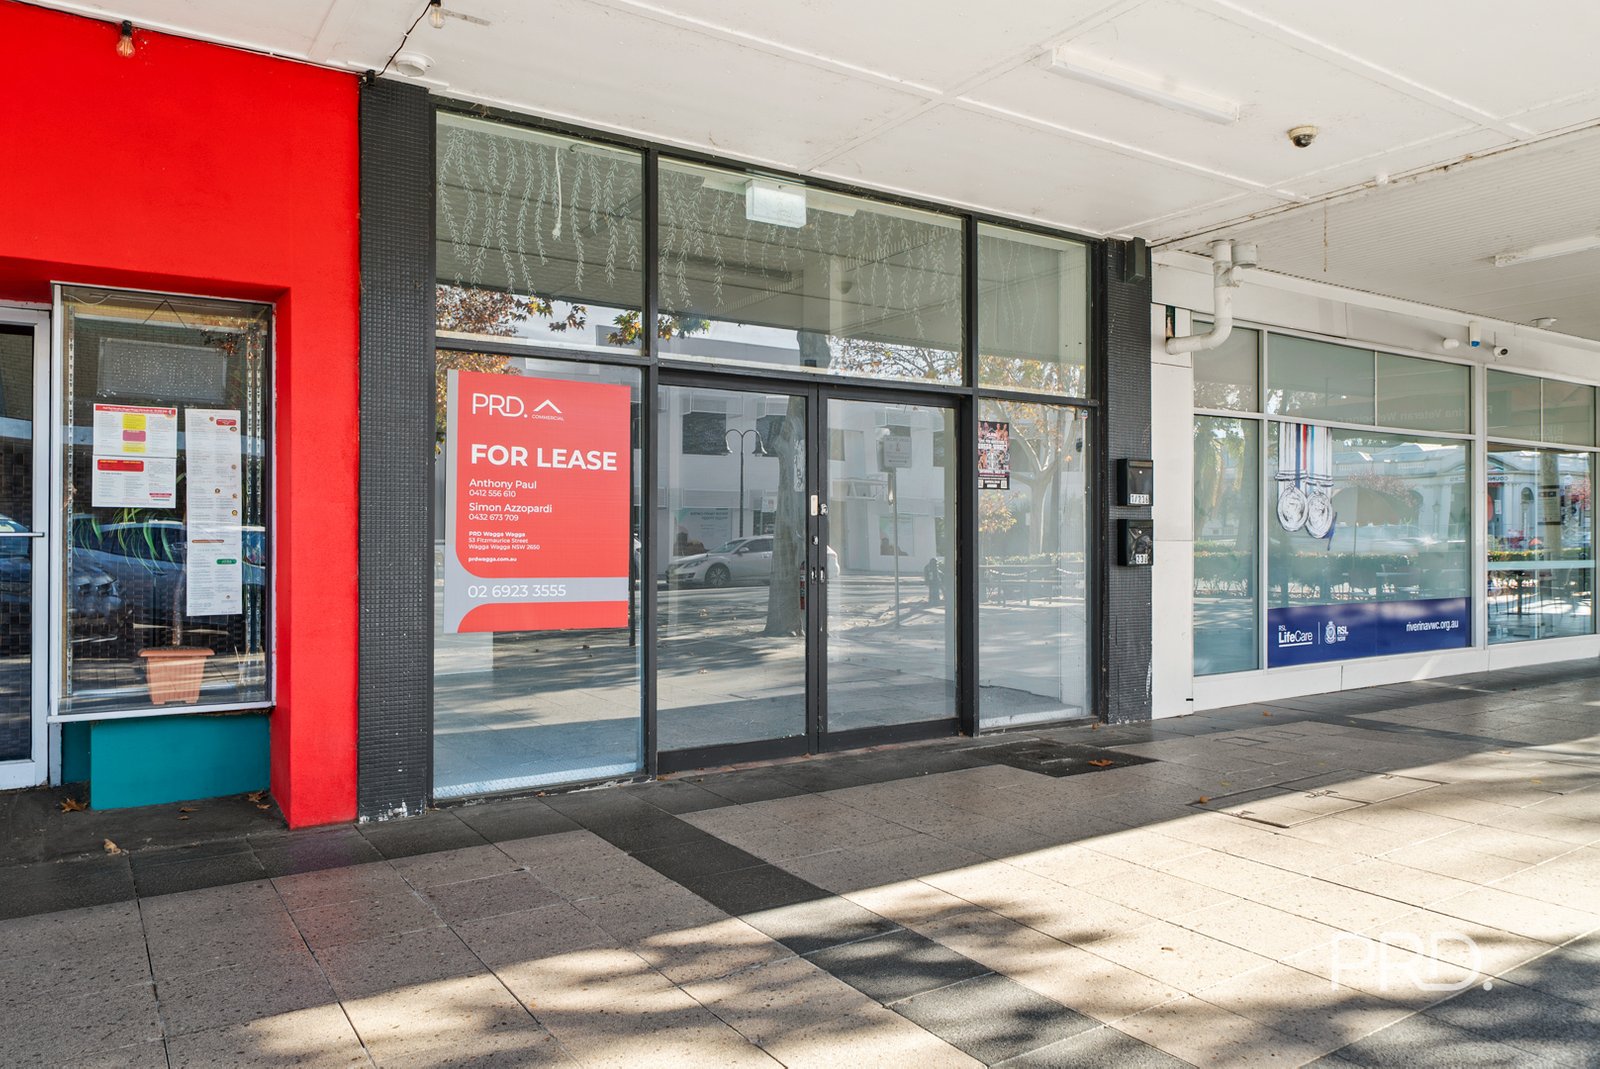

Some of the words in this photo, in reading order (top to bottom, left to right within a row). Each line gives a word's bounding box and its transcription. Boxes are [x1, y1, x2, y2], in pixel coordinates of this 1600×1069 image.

[472, 393, 528, 418] PRD.
[471, 444, 528, 467] FOR
[537, 447, 617, 471] LEASE
[469, 479, 513, 489] Anthony
[515, 480, 537, 489] Paul
[469, 489, 487, 497] 0412
[503, 490, 516, 498] 610
[469, 502, 501, 512] Simon
[504, 503, 553, 514] Azzopardi
[467, 585, 488, 598] 02
[491, 585, 529, 597] 6923
[532, 584, 567, 597] 3555
[1337, 625, 1349, 635] RSL
[1406, 620, 1459, 632] riverinavwc.org.au
[1278, 630, 1313, 643] LifeCare
